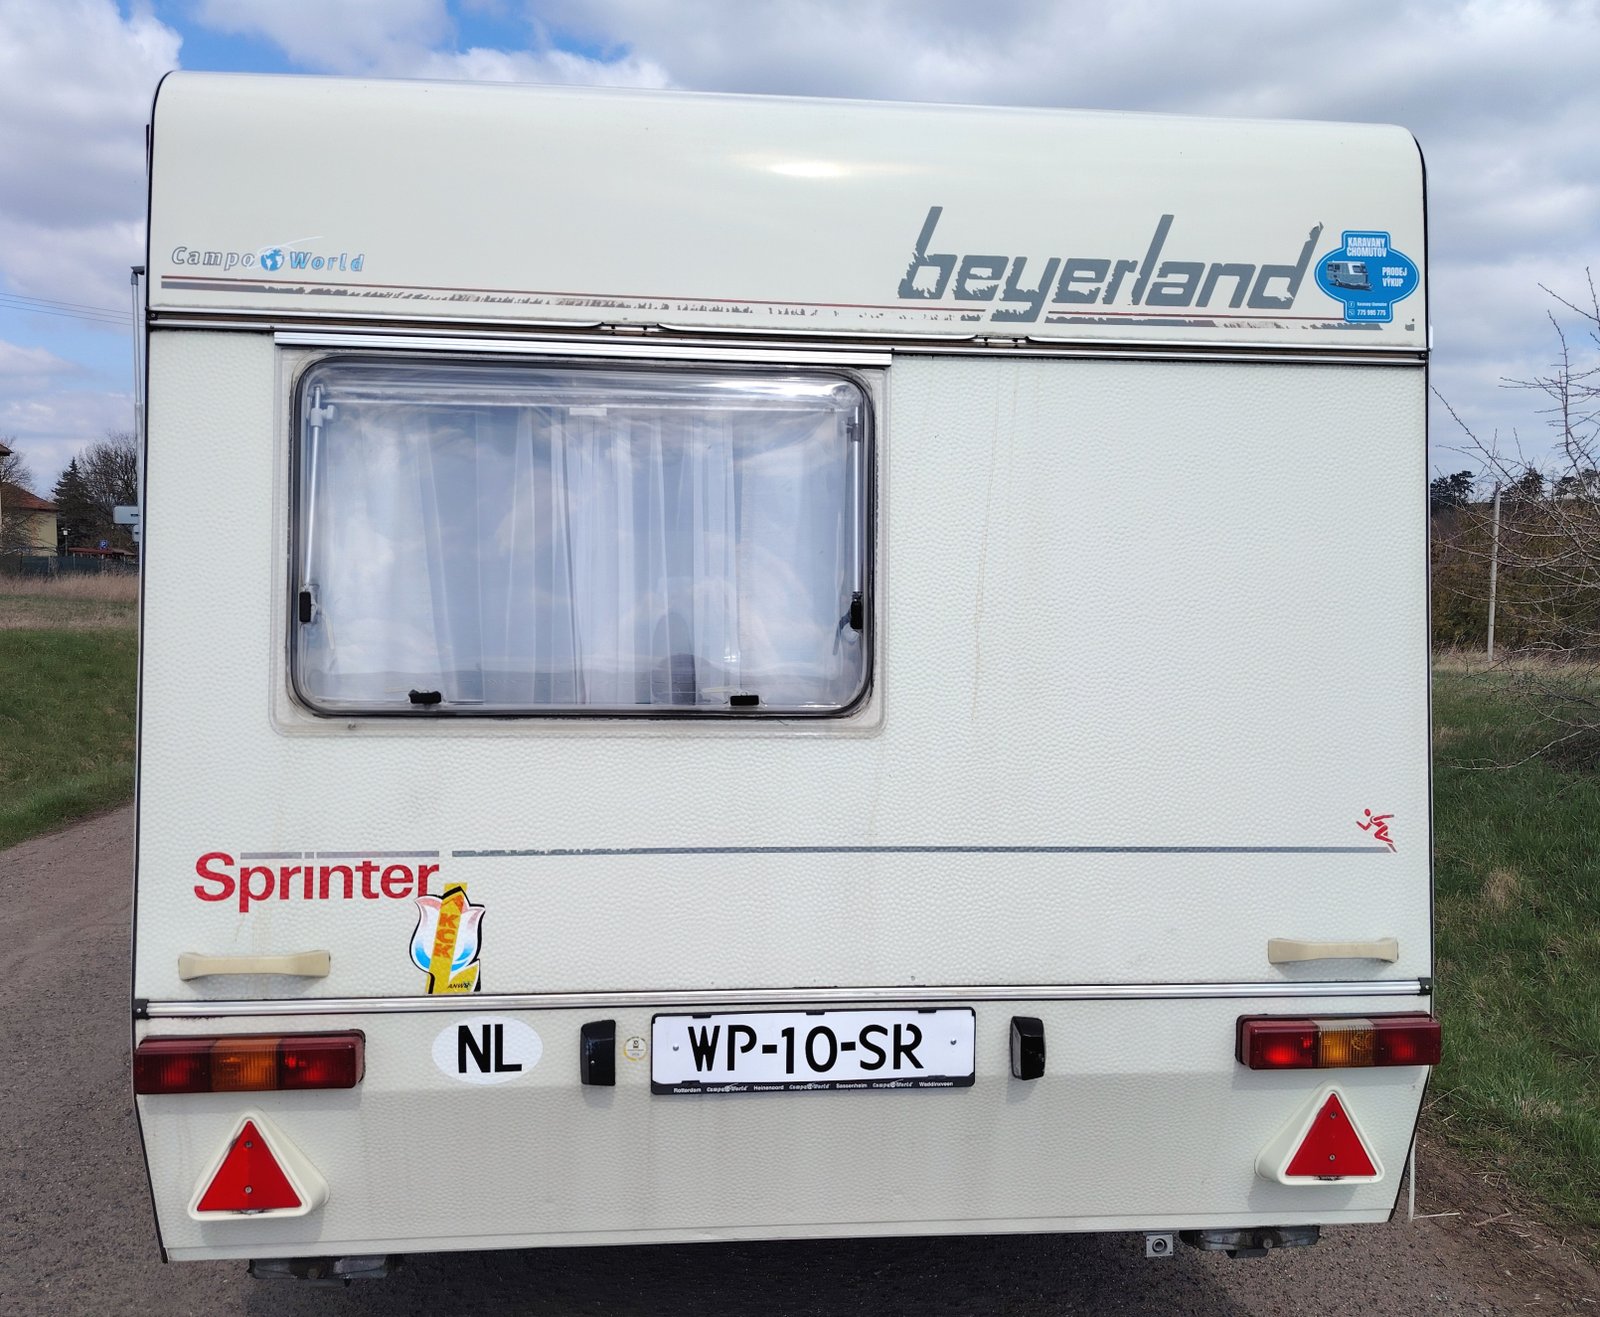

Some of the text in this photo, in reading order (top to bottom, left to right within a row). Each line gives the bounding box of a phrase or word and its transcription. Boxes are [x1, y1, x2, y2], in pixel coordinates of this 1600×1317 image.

[171, 246, 366, 272] Campo World
[1346, 247, 1387, 257] CHOMUTOV
[1347, 237, 1386, 247] KARAVANY
[898, 206, 1324, 322] beyerland
[1382, 267, 1407, 276] PRODEJ
[1382, 277, 1403, 287] VÝKUP
[193, 851, 440, 913] Sprinter
[433, 913, 459, 959] KCK
[458, 1023, 523, 1073] NL
[687, 1024, 924, 1074] WP-10-SR
